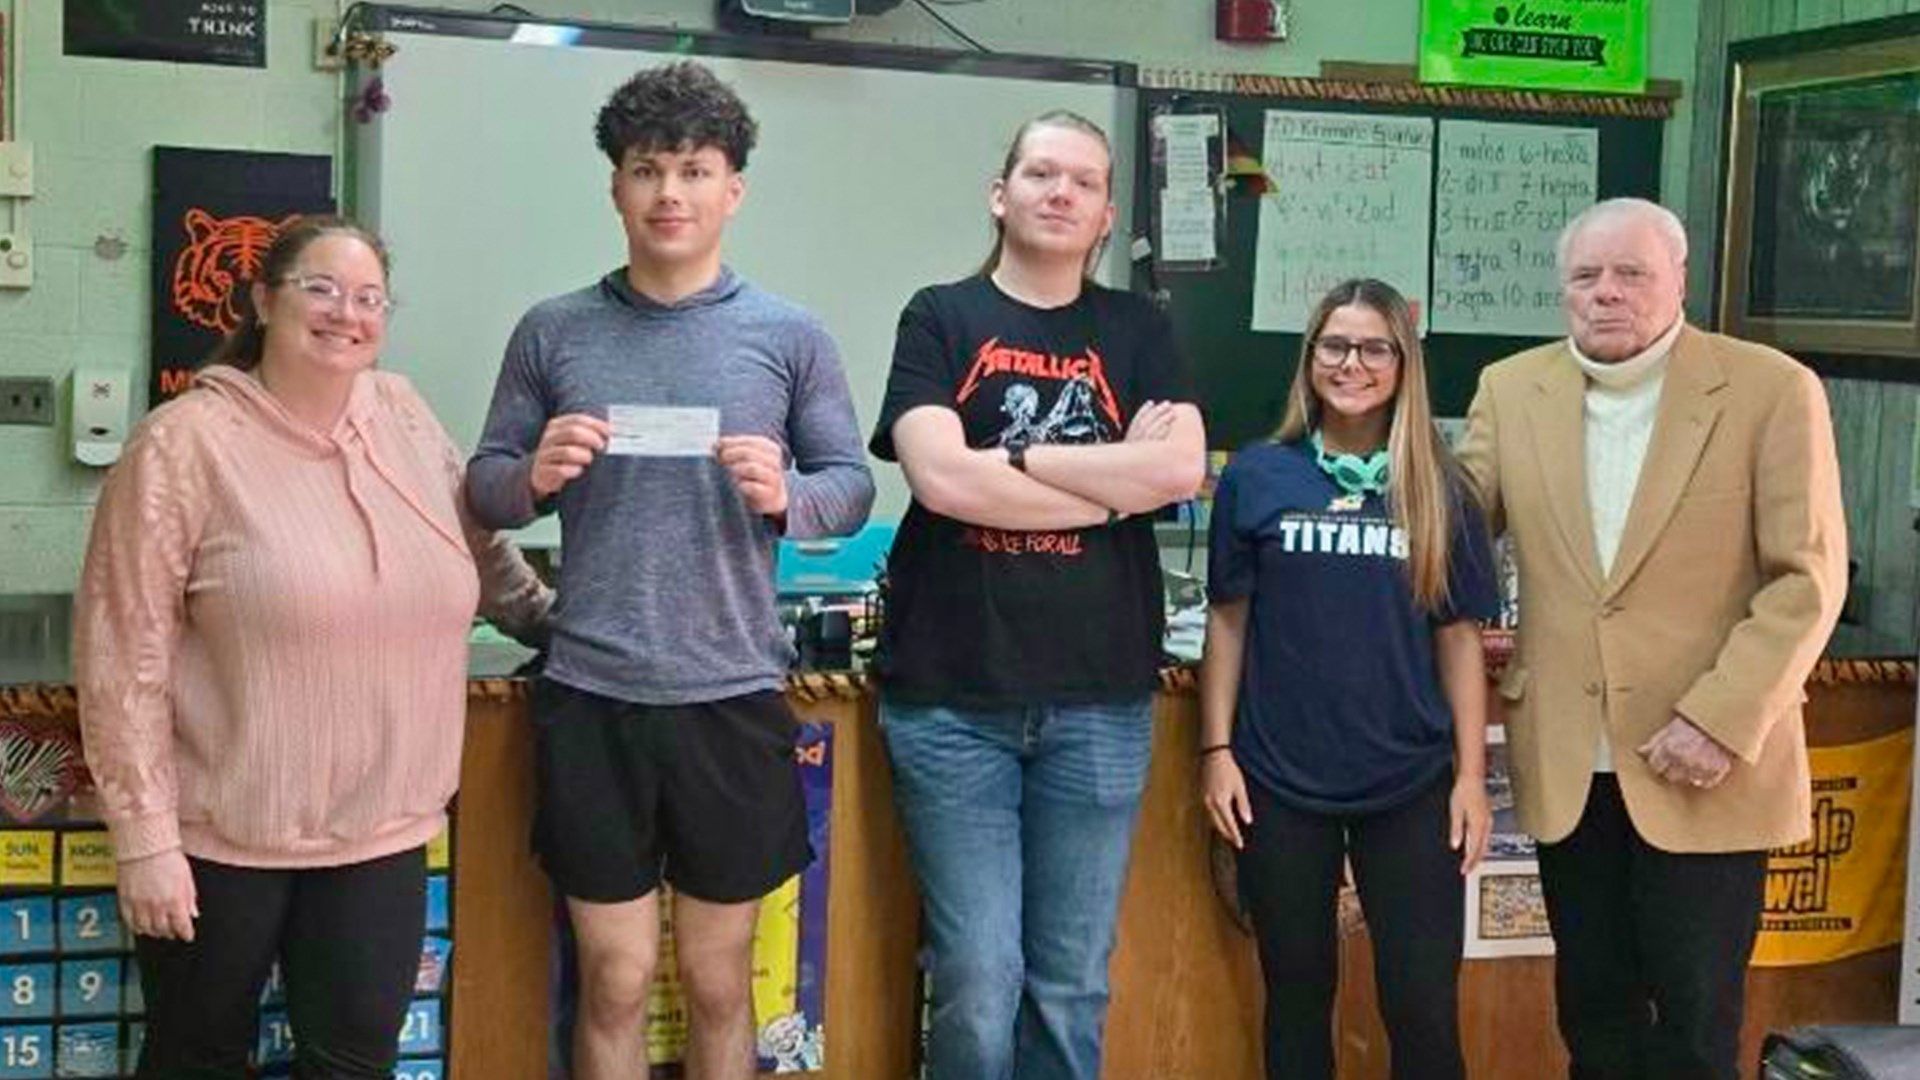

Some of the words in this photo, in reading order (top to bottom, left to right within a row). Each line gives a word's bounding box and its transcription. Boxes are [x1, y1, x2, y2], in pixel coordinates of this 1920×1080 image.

[189, 16, 256, 37] THINK
[1513, 3, 1573, 29] learn
[956, 337, 1122, 430] METALLICA
[1279, 519, 1410, 559] TITANS
[13, 908, 30, 940] 1
[78, 907, 101, 938] 2
[13, 975, 35, 1005] 8
[79, 970, 101, 1002] 9
[3, 1035, 40, 1067] 15
